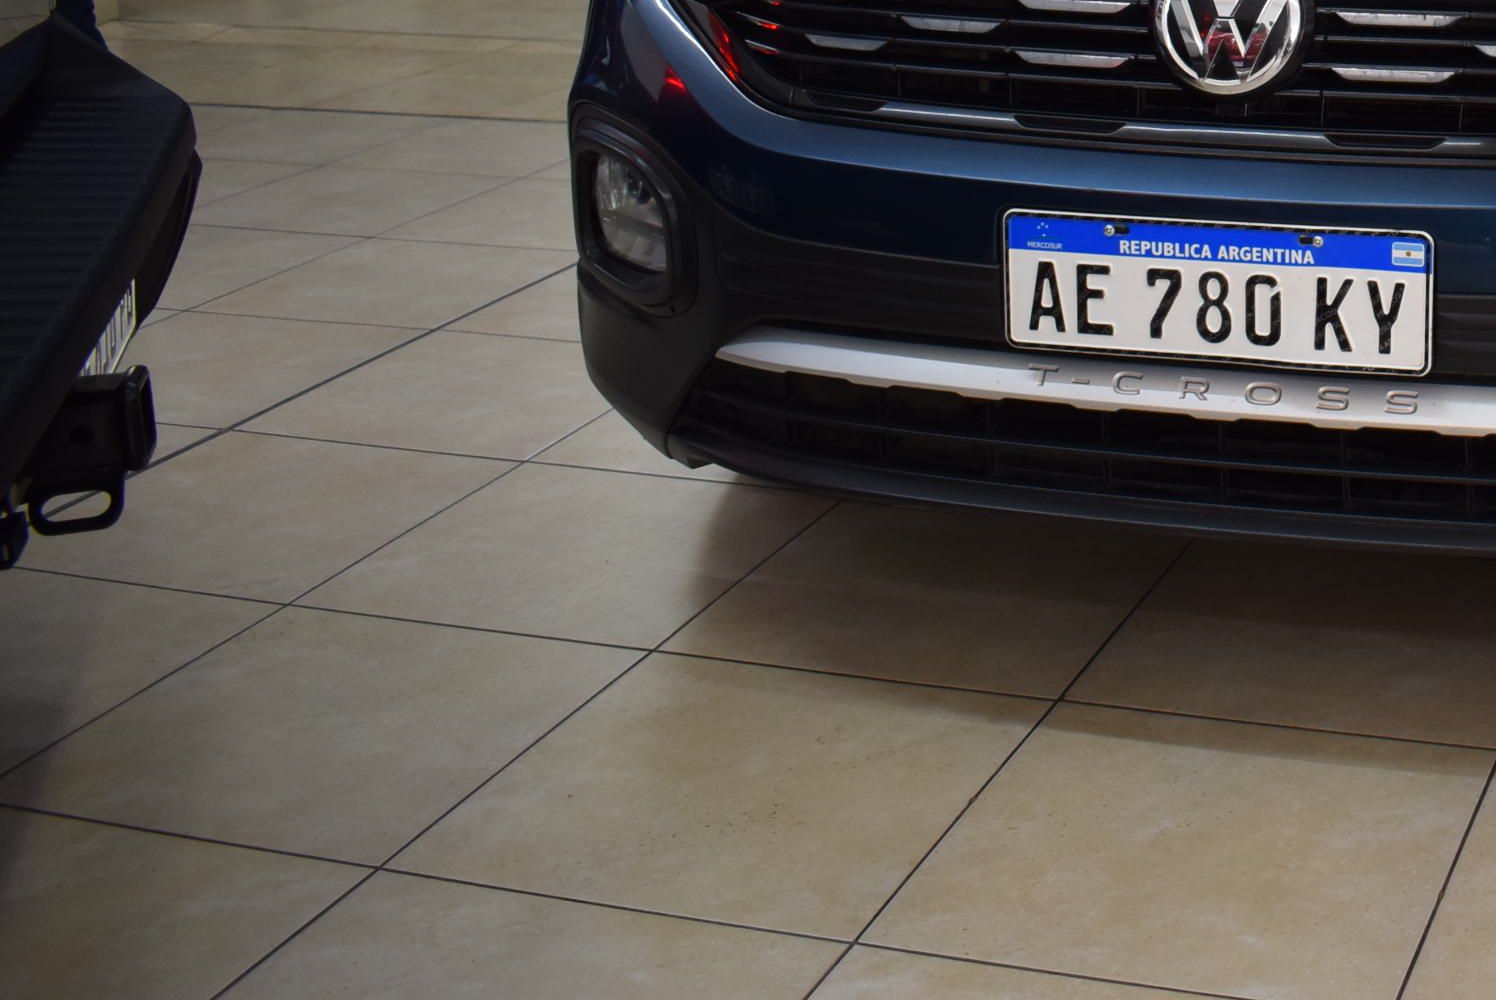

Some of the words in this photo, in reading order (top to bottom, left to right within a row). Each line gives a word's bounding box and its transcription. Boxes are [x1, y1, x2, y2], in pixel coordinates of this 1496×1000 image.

[1026, 240, 1063, 250] MERCOSUR
[1119, 239, 1213, 260] REPUBLICA
[1217, 245, 1315, 265] ARGENTINA
[1028, 260, 1115, 337] AE
[1146, 268, 1282, 347] 780
[1313, 276, 1406, 355] KY
[1028, 362, 1420, 416] T-CROSS
